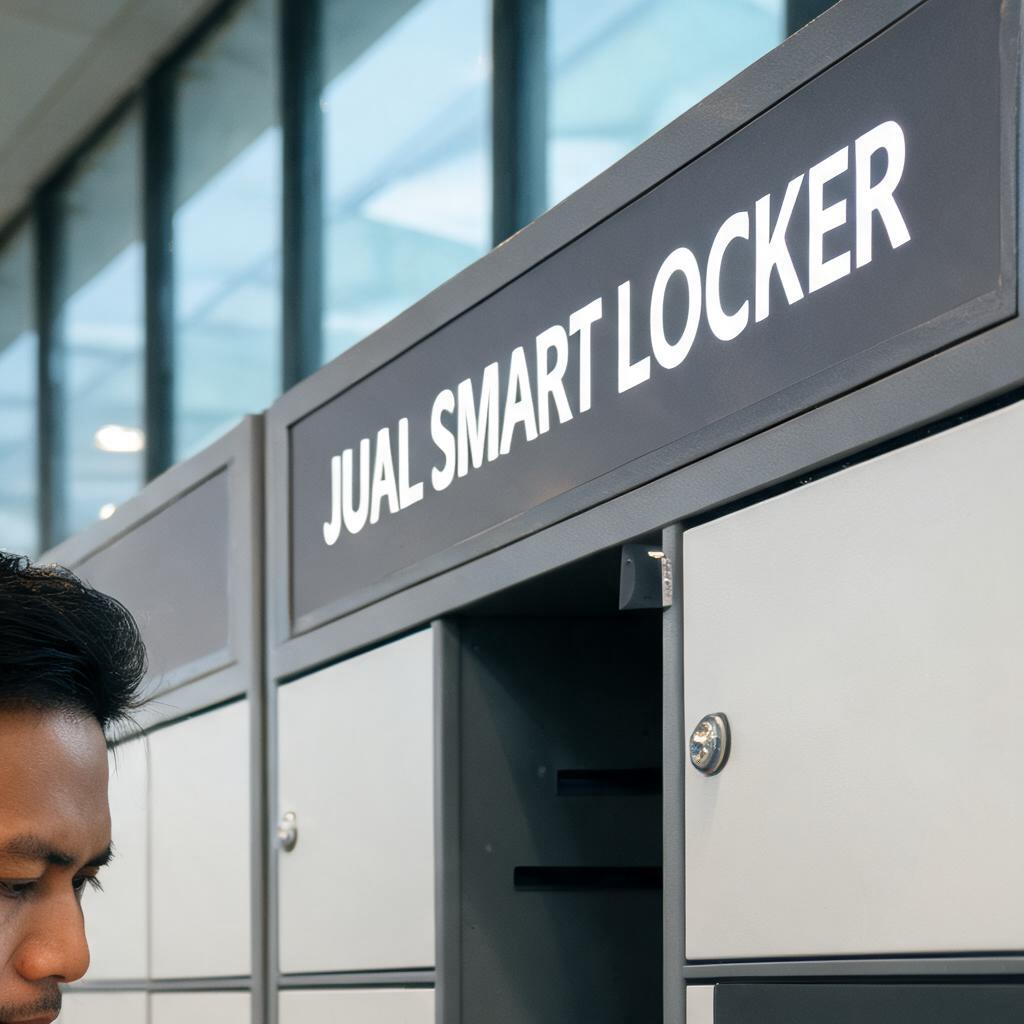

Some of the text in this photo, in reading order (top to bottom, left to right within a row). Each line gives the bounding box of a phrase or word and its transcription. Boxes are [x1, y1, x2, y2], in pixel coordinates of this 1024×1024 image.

[323, 120, 911, 546] JUAL SMART LOCKER
